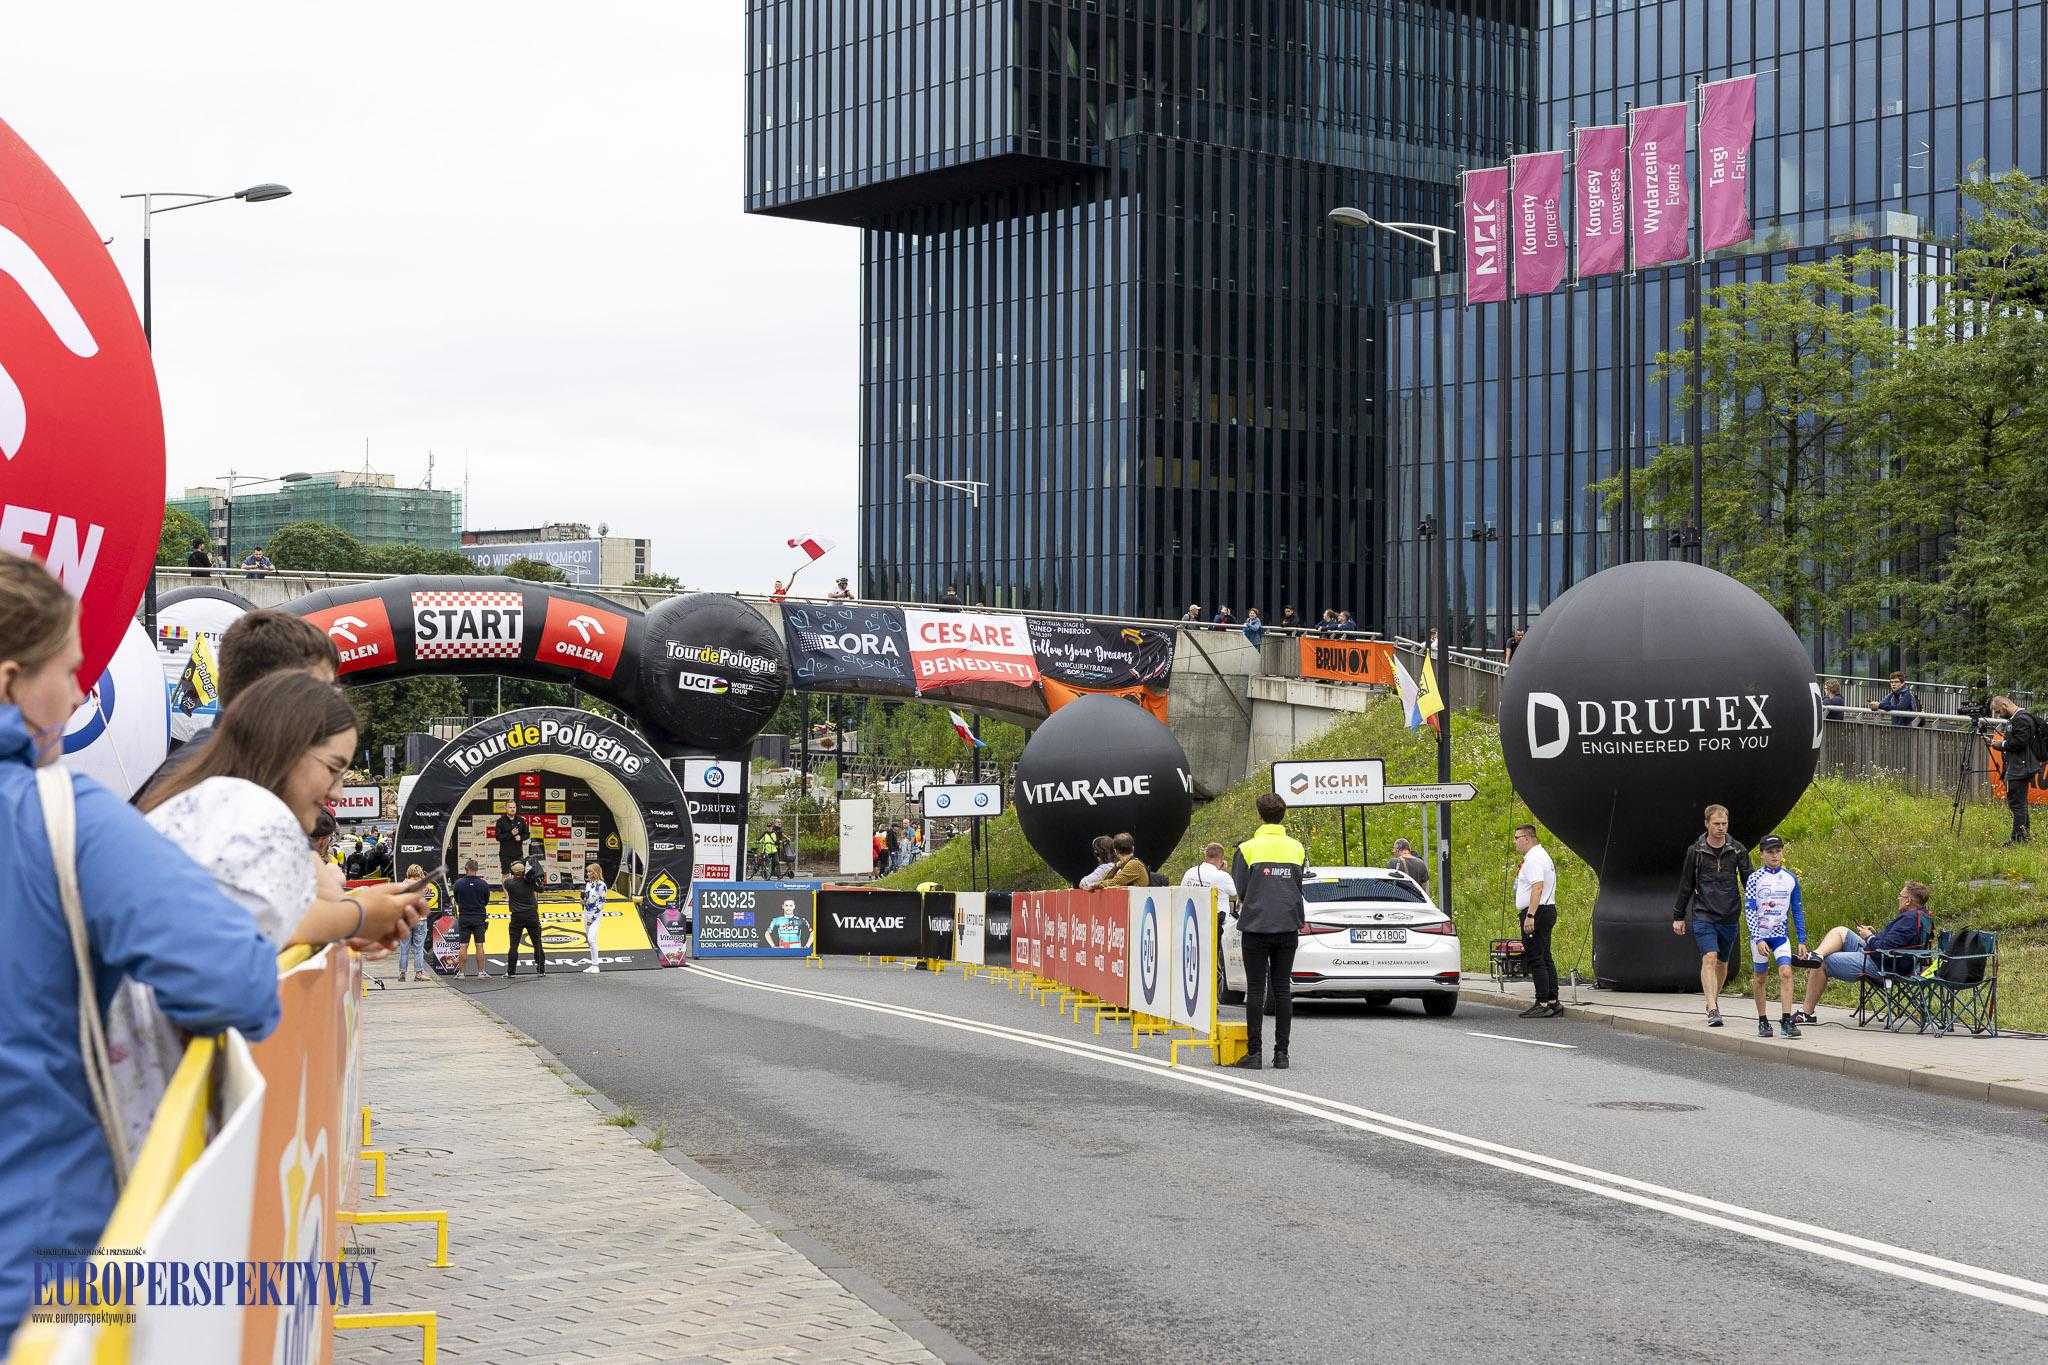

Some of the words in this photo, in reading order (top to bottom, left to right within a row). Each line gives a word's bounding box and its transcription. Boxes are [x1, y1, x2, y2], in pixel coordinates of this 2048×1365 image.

[1709, 146, 1728, 187] Targi
[1641, 141, 1662, 235] Wydarzenia
[1666, 163, 1680, 206] Events
[1586, 169, 1604, 237] Kongresy
[1609, 167, 1623, 235] Congresses
[1521, 194, 1539, 256] Koncerty
[1544, 198, 1557, 248] Concerts
[416, 609, 522, 641] START
[920, 622, 1015, 648] CESARE
[339, 643, 379, 662] RLEN
[555, 641, 604, 663] ORLEN
[821, 632, 901, 657] BORA
[1064, 644, 1093, 661] Your
[1093, 645, 1134, 664] Dreams
[920, 657, 1034, 681] BENEDETTI
[683, 675, 710, 690] UCI
[731, 682, 753, 690] WORLD
[1577, 694, 1773, 736] DRUTEX
[1582, 739, 1690, 755] ENGINEERED
[1698, 738, 1731, 752] FOR
[1738, 736, 1769, 749] YOU
[1022, 774, 1150, 806] VITARADE
[1314, 774, 1369, 788] KGHM
[700, 803, 736, 813] DRUTEX
[1420, 793, 1462, 801] Kongresowe
[703, 835, 733, 844] KGHM
[701, 891, 756, 909] 13:09:25
[705, 915, 727, 925] NZL
[831, 912, 905, 934] VITARADE
[700, 927, 750, 939] ARCHBOLD
[751, 927, 760, 939] S.
[1356, 930, 1373, 940] WPI
